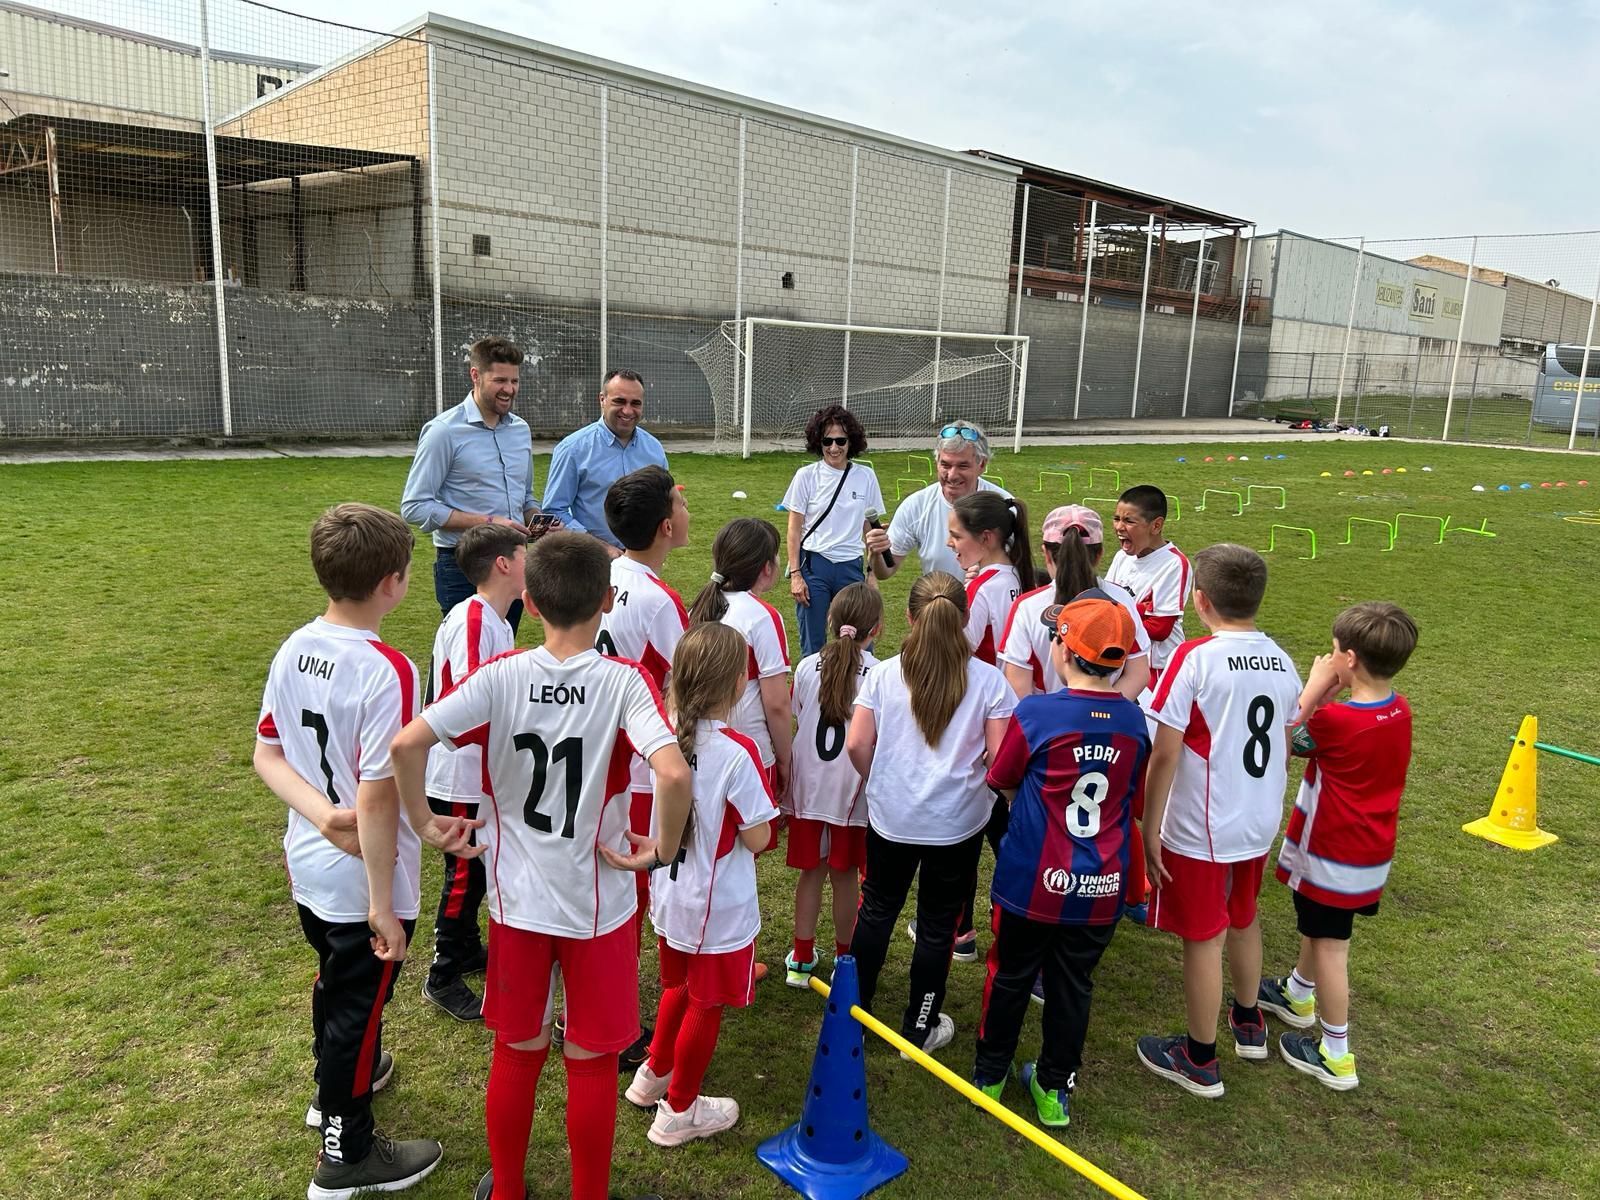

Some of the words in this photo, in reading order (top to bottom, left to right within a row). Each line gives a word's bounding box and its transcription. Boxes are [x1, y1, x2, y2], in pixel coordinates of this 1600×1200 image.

[1412, 288, 1436, 315] Sani
[298, 654, 335, 680] UNAI
[1227, 656, 1287, 673] MIGUEL
[529, 683, 585, 705] LEÓN
[1243, 694, 1275, 779] 8
[301, 708, 341, 805] 7
[1072, 745, 1121, 764] PEDRI
[513, 732, 583, 839] 21
[1065, 771, 1109, 838] 8
[1076, 882, 1119, 894] ACNUR
[1079, 872, 1120, 885] UNHCR
